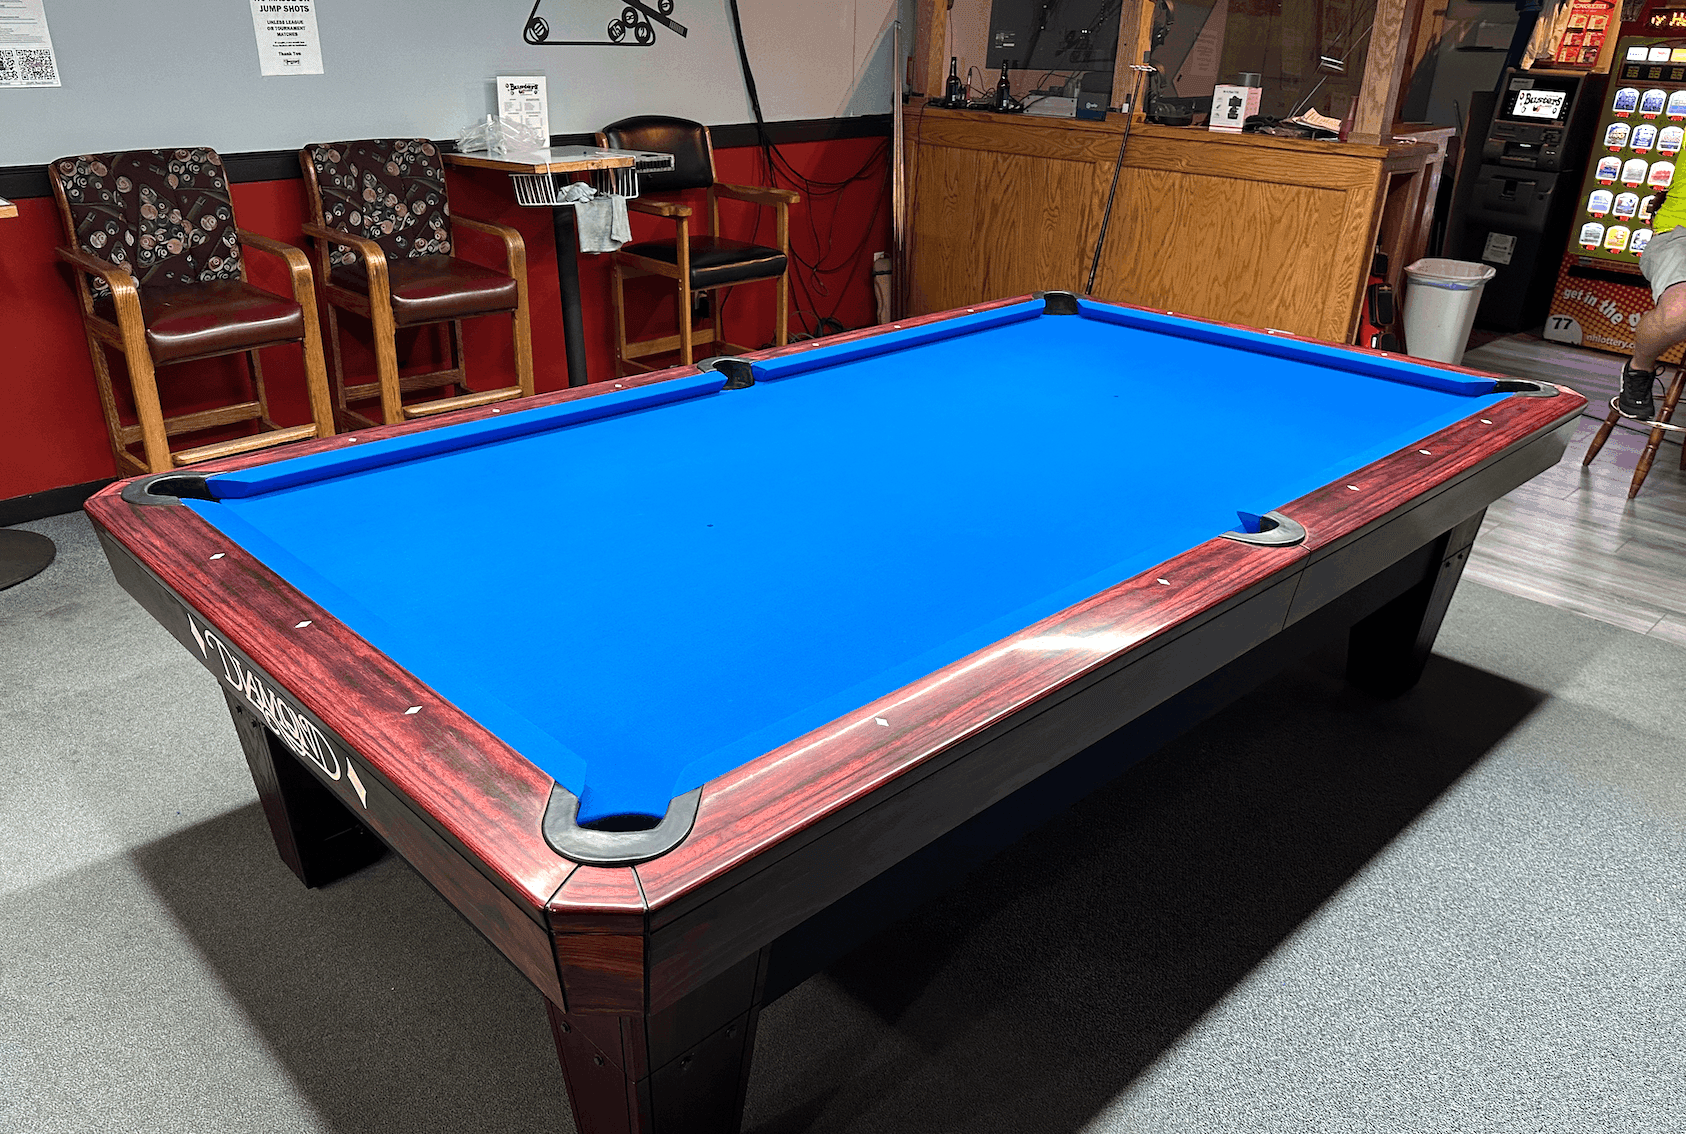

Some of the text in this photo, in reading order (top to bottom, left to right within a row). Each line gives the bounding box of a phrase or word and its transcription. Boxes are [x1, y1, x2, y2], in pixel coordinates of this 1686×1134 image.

[259, 5, 310, 13] JUMP SHOTS
[1524, 93, 1563, 106] Busters
[1563, 288, 1584, 301] get
[1583, 291, 1598, 307] in
[1598, 300, 1624, 325] the
[1552, 317, 1574, 330] 77
[1586, 334, 1636, 350] nhlottery.c
[204, 629, 342, 781] DIAMOND
